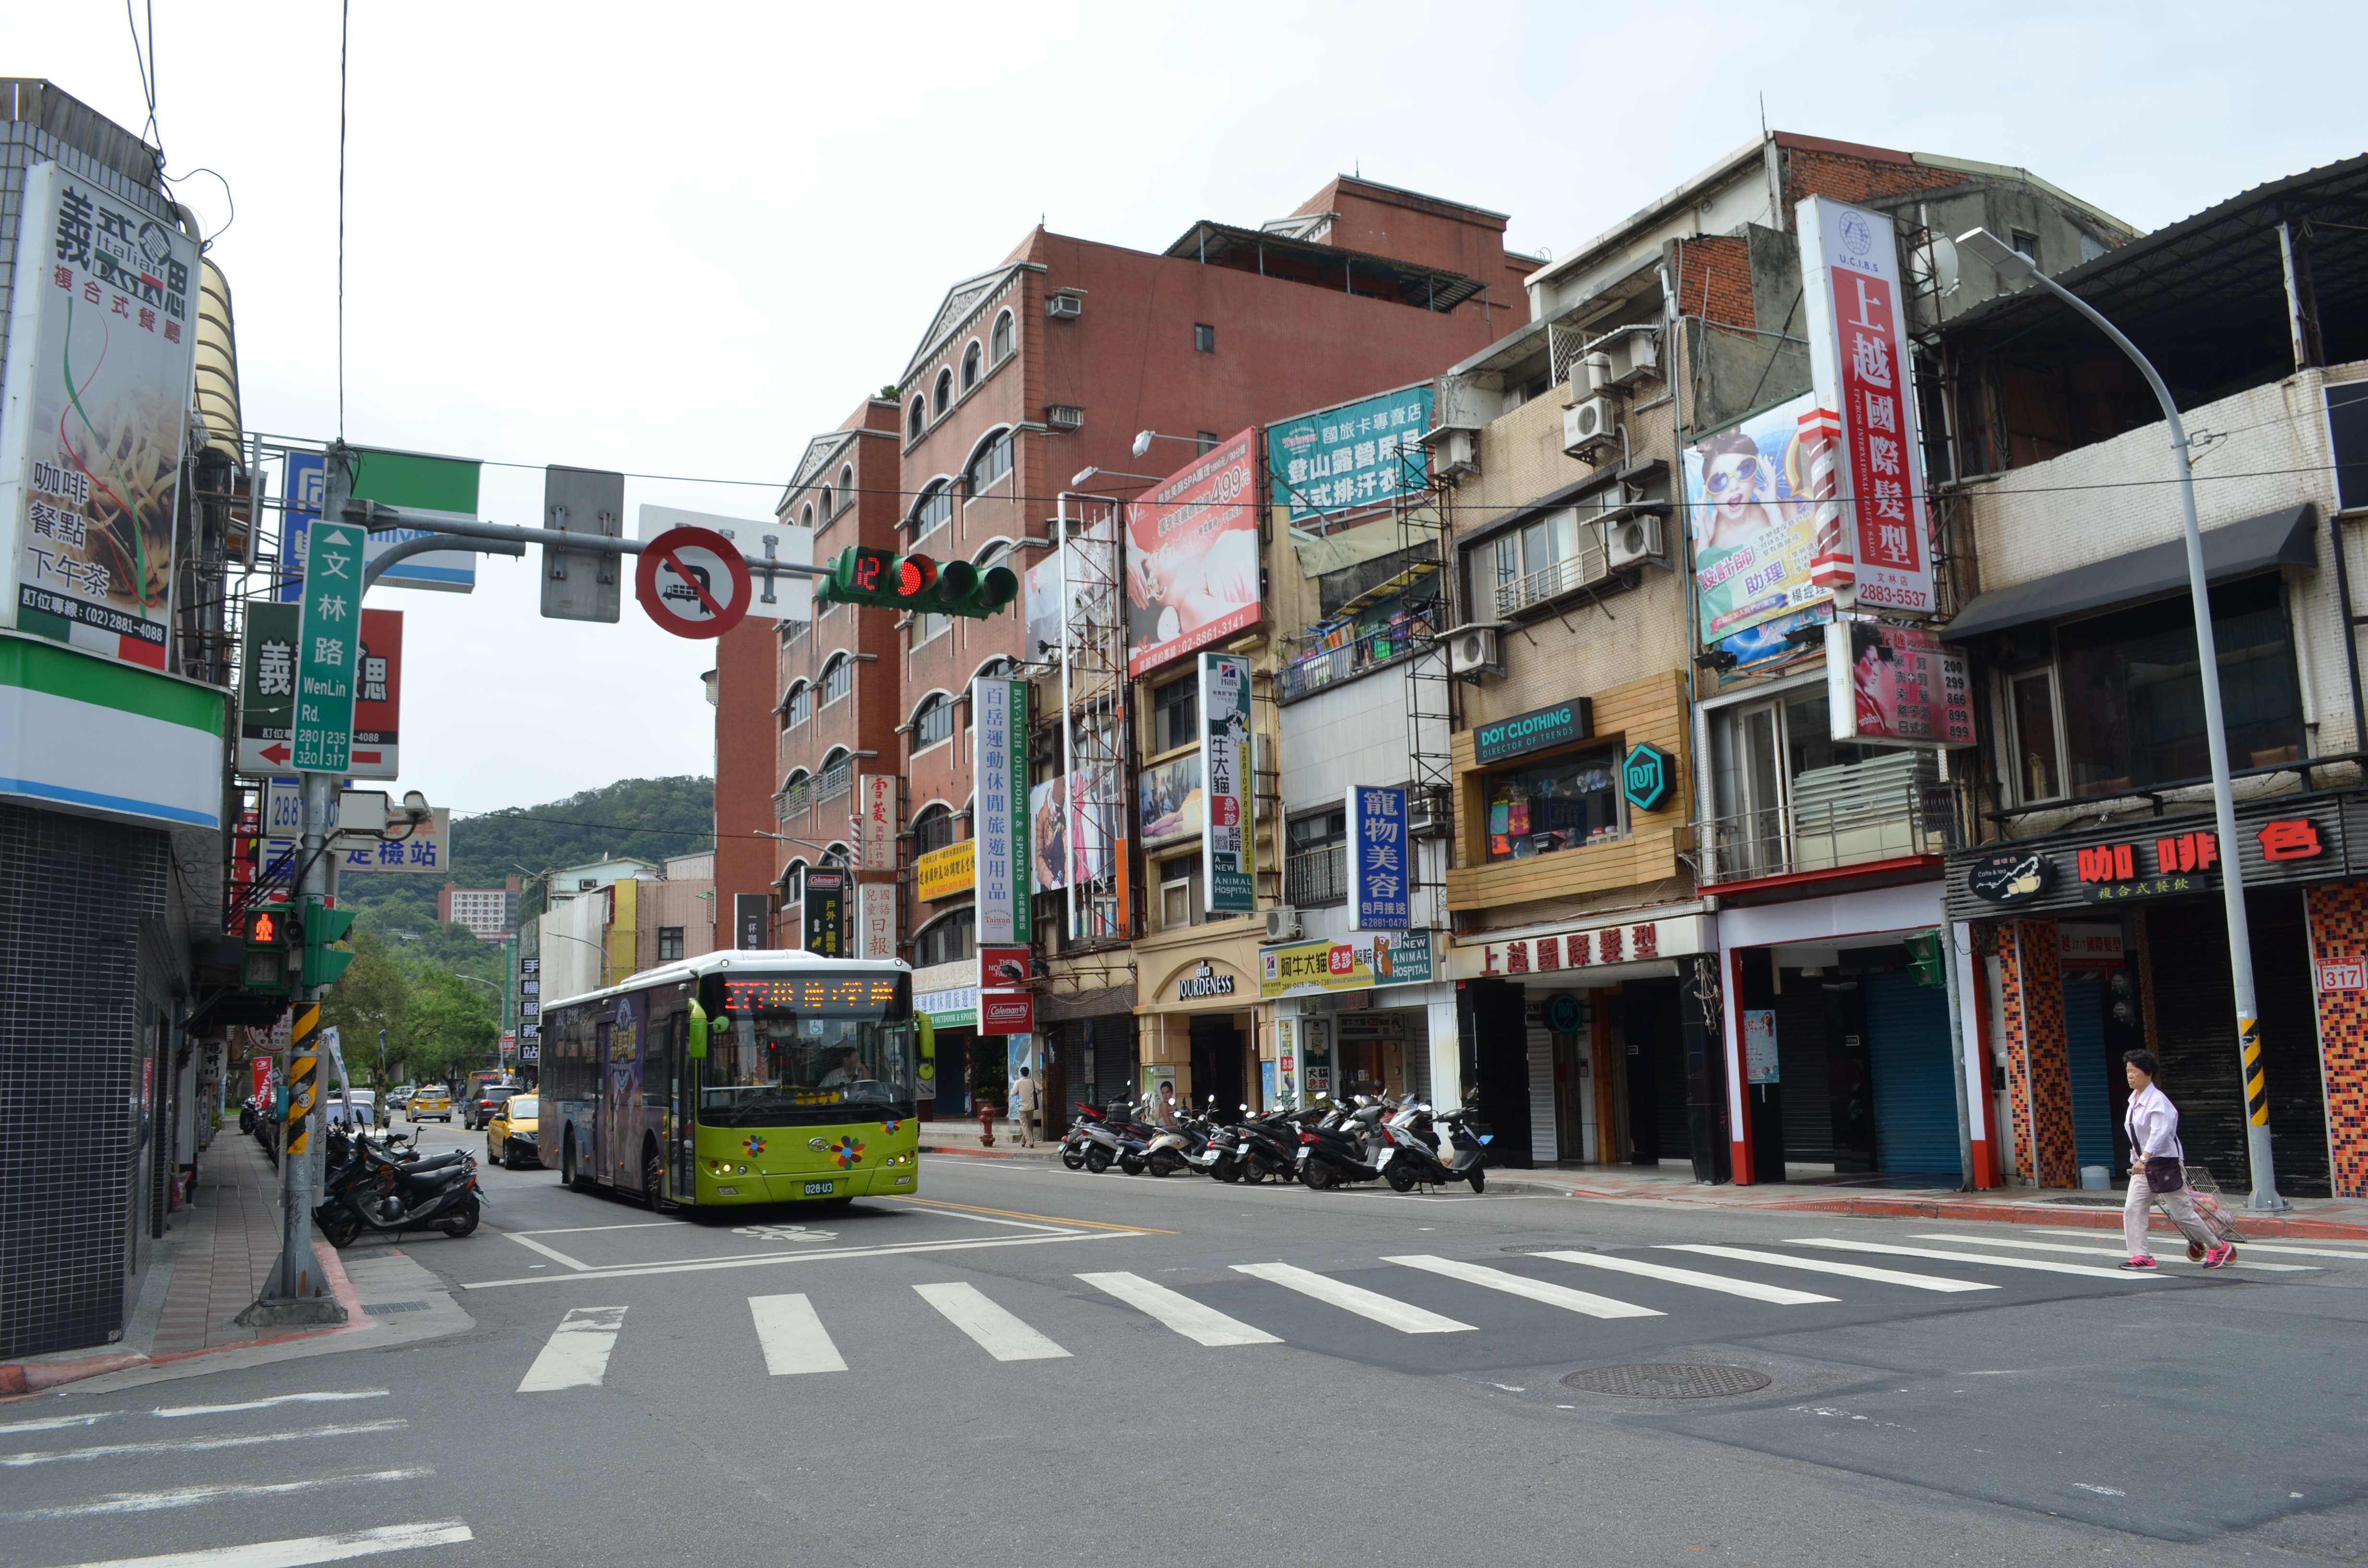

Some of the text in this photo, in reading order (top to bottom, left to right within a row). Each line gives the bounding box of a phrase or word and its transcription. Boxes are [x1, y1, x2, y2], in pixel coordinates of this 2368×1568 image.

[96, 231, 164, 281] Italian
[96, 257, 161, 308] PASTA
[53, 263, 181, 344] 複合式餐廳
[1322, 403, 1422, 445] 國旅卡專賣店
[1848, 278, 1912, 565] 上越國際髮型
[33, 461, 88, 505] 咖啡
[29, 502, 87, 551] 餐點
[26, 546, 110, 600] 下午茶
[857, 556, 880, 590] 12
[1697, 547, 1754, 591] 設計師
[1745, 561, 1786, 596] 助理
[1876, 573, 1908, 587] 文林店
[314, 551, 351, 666] 文林路
[1860, 583, 1926, 609] 2883-5537
[1944, 661, 1962, 673] 200
[304, 676, 346, 698] WenLin
[1946, 676, 1964, 690] 299
[1947, 693, 1966, 705] 866
[302, 705, 320, 723] Rd.
[1949, 710, 1967, 722] 899
[298, 729, 346, 745] 280 235
[1481, 708, 1572, 746] DOT CLOTHING
[1949, 726, 1969, 738] 899
[1483, 726, 1573, 758] DIRECTOR OF TRENDS
[297, 751, 345, 767] 320 317
[986, 687, 1006, 901] 百岳運動休閒旅遊用品
[1013, 688, 1024, 882] BAY-YUEH OUTDOOR & SPORTS
[1224, 798, 1236, 826] 急診
[1229, 827, 1241, 852] 醫院
[1364, 790, 1399, 899] 寵物美容
[810, 876, 834, 884] Coleman
[1215, 876, 1251, 885] ANIMAL
[1215, 886, 1252, 897] HOSPITAL
[2098, 876, 2190, 900] 複合式餐飲
[866, 889, 890, 915] 兒童 國語
[1361, 901, 1406, 915] 包月接送
[1368, 917, 1407, 929] 2881-0478
[870, 919, 889, 956] 日報
[1403, 939, 1426, 949] NEW
[1480, 923, 1658, 976] 上越國際髮型
[1281, 949, 1372, 978] 阿牛犬貓 急診 醫院
[1393, 950, 1428, 963] ANIMAL
[1196, 968, 1210, 977] BIO
[1393, 965, 1429, 981] HOSPITAL
[2326, 970, 2357, 986] 317
[1178, 976, 1233, 1001] JOURDENESS
[523, 959, 539, 1059] 手機服務站
[935, 1015, 955, 1024] OUTDOOR
[990, 1006, 1019, 1016] Coleman
[1308, 1068, 1328, 1078] 犬貓
[805, 1183, 832, 1194] 028-U3
